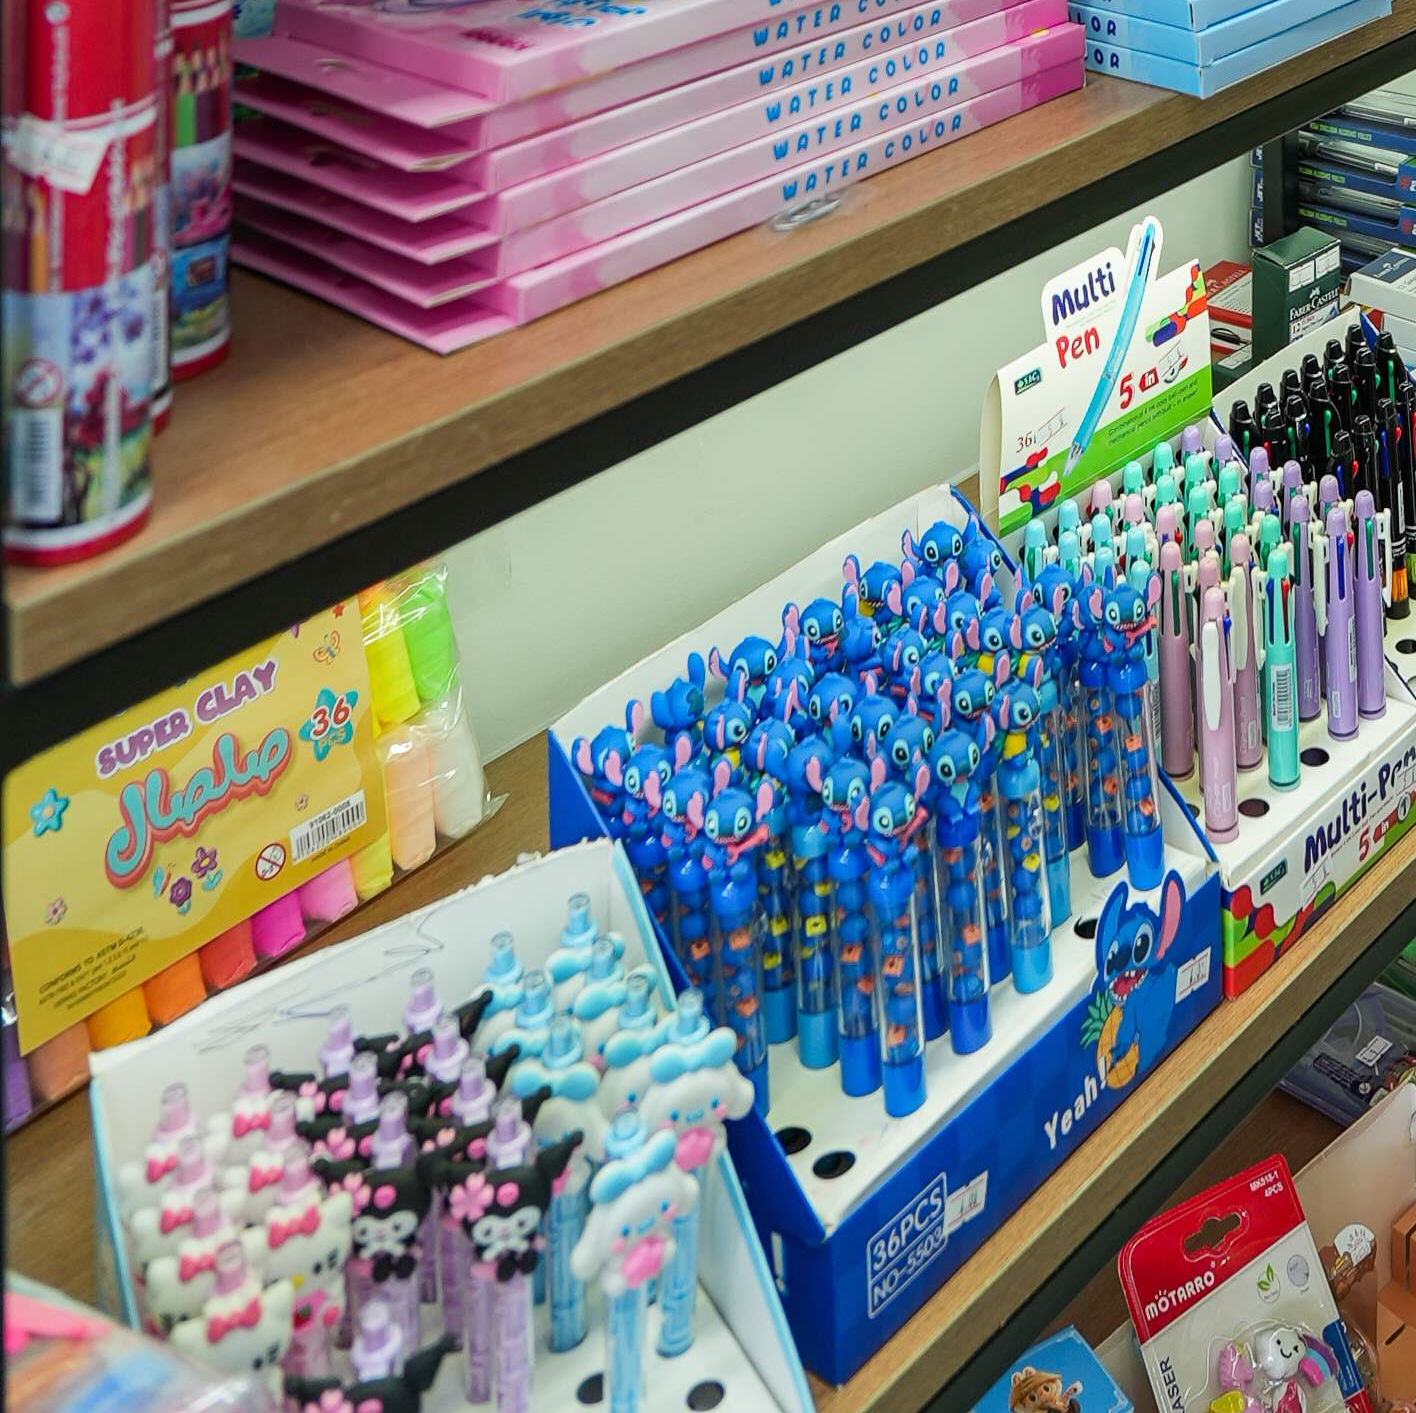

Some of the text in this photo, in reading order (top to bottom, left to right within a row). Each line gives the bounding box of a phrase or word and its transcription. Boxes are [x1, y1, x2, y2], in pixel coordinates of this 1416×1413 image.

[753, 3, 841, 46] WATER
[758, 8, 942, 85] WATER COLOR
[765, 41, 946, 123] WATER COLOR
[773, 76, 960, 161] WATER COLOR
[782, 113, 962, 200] WATER COLOR
[1052, 261, 1116, 326] Multi
[1289, 288, 1340, 321] FABER-CASTELL
[1056, 326, 1101, 369] Pen
[1119, 371, 1156, 410] 5 in
[97, 660, 278, 776] SUPER CLAY
[311, 696, 351, 739] 36
[318, 728, 347, 749] PCS
[104, 728, 292, 889] صلصال
[1358, 827, 1371, 863] 5
[1380, 820, 1391, 836] in
[1042, 1054, 1109, 1151] Yeah!
[1263, 1181, 1285, 1199] 4PCS
[872, 1186, 943, 1272] 36PCS
[872, 1223, 946, 1308] NO-5503
